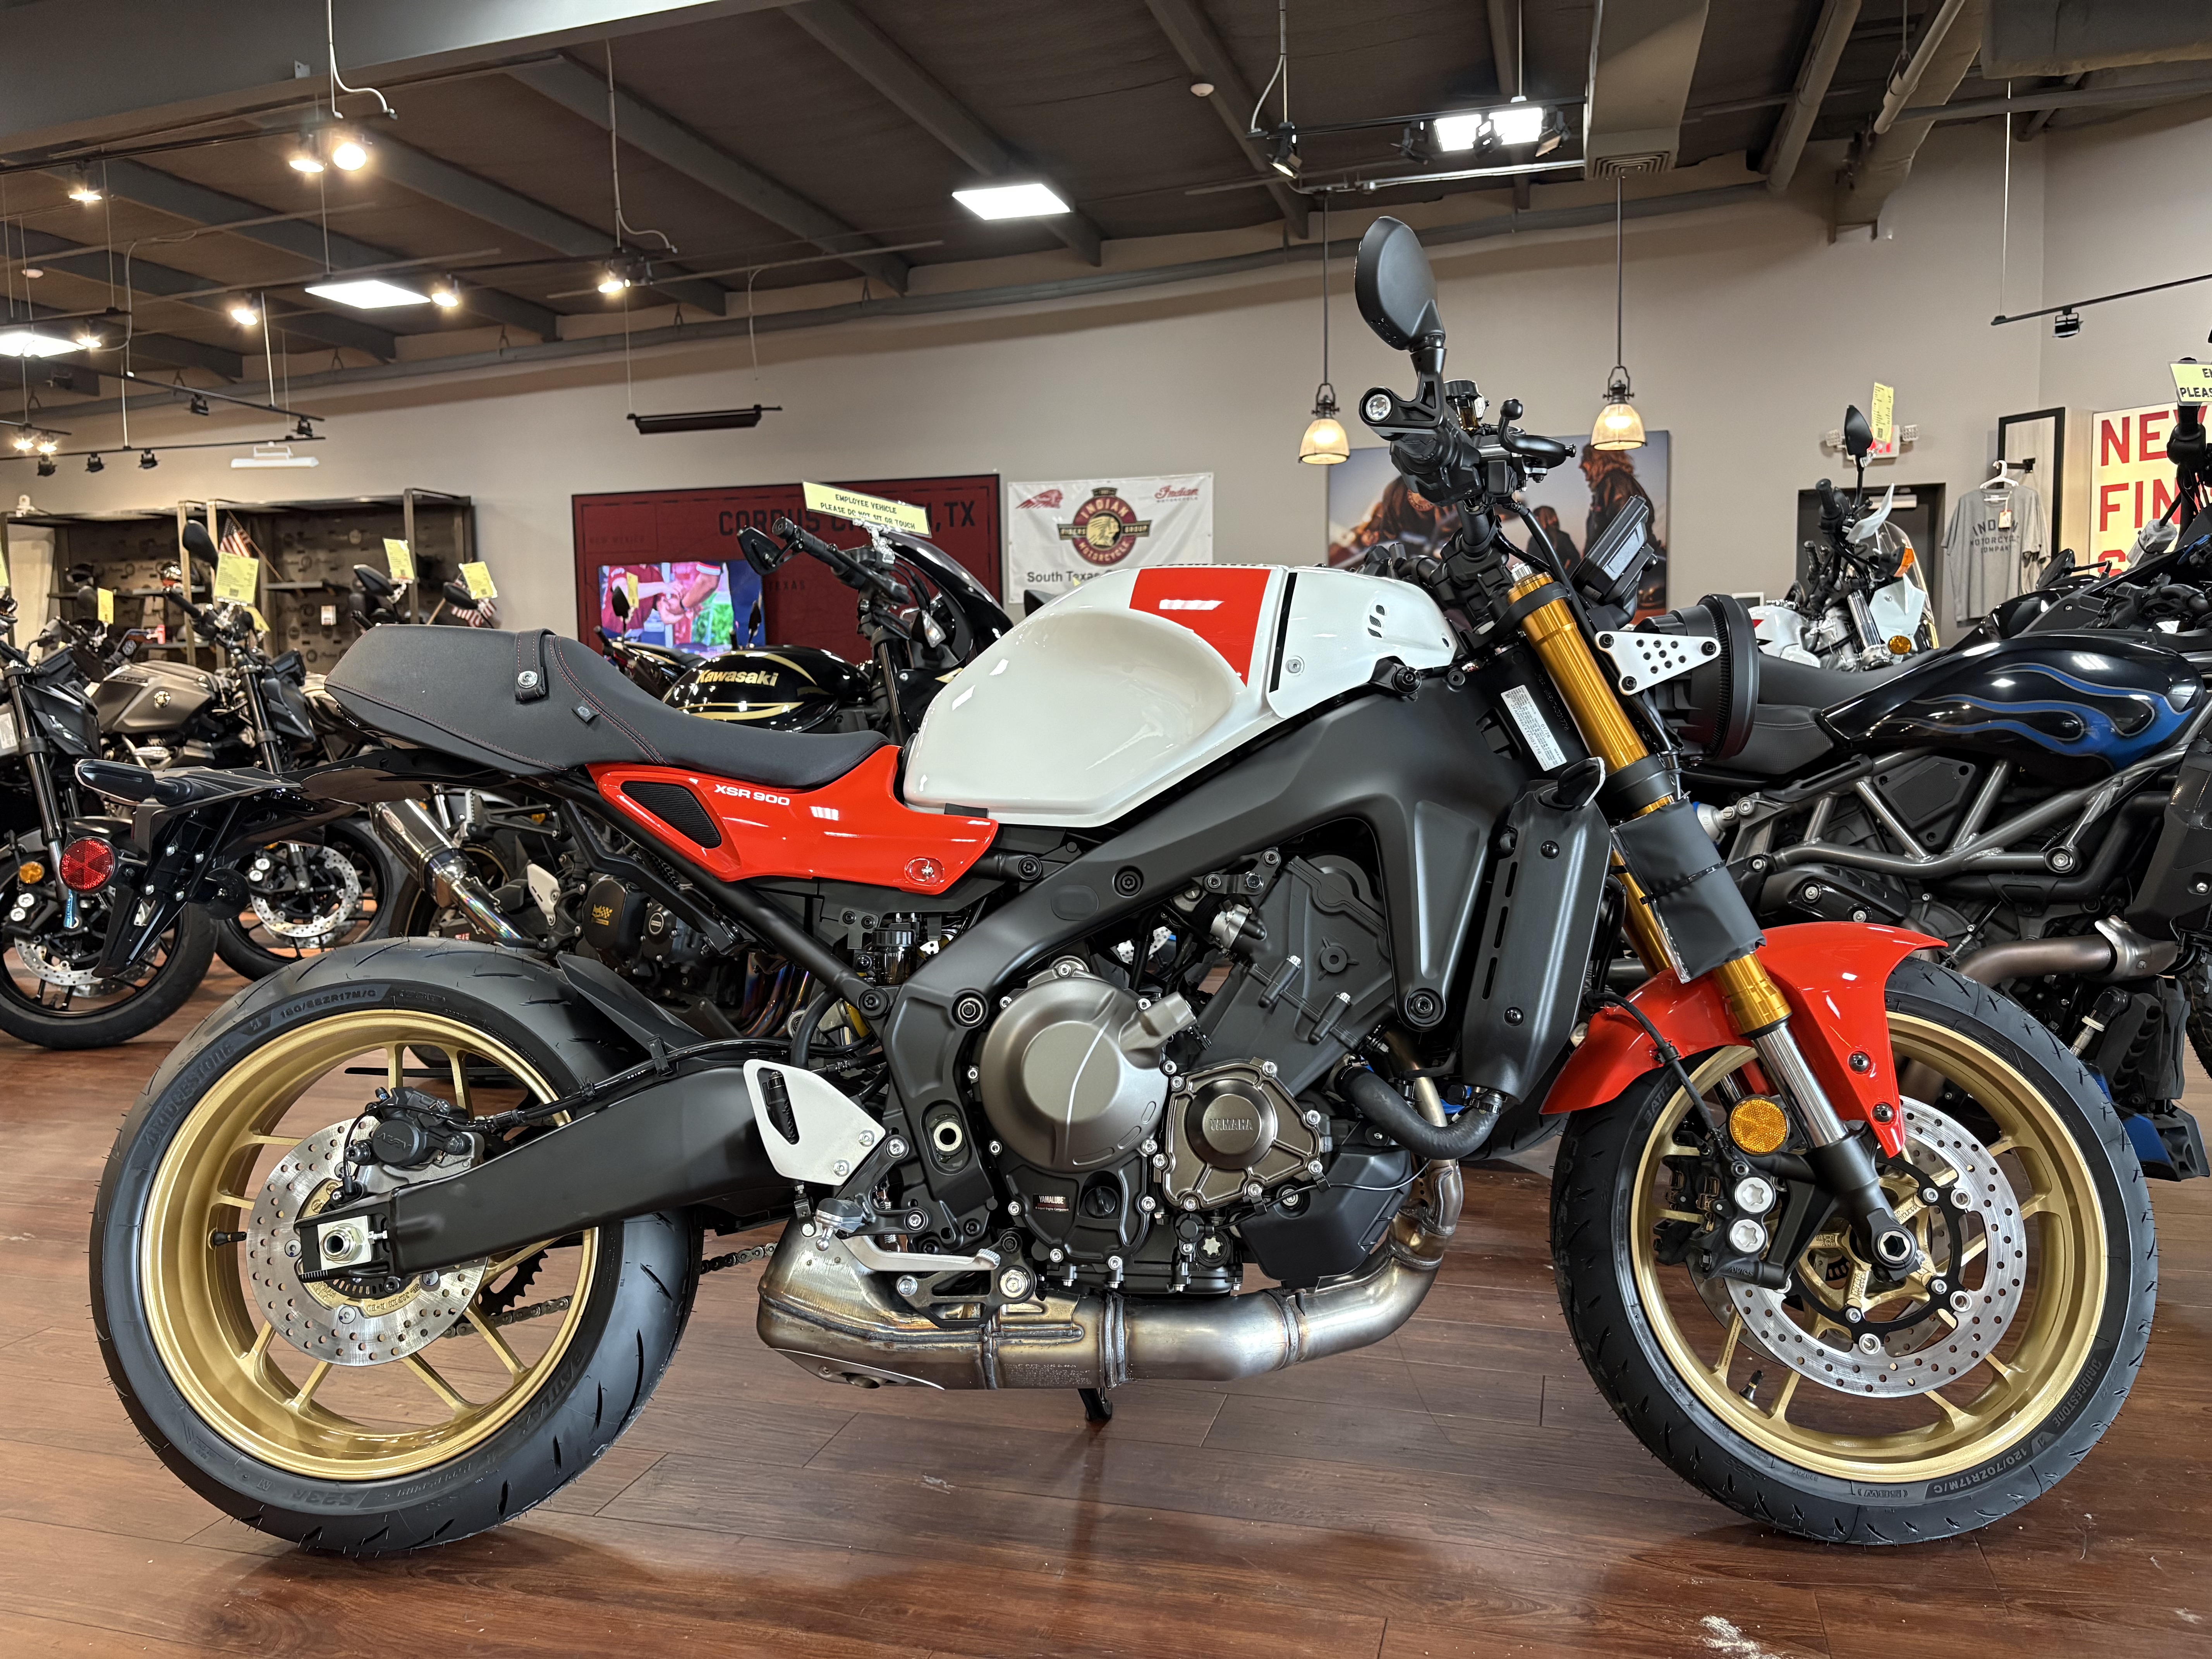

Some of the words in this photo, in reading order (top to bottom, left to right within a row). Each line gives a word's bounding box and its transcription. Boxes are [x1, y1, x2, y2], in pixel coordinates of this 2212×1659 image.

[2101, 405, 2208, 467] NE
[835, 494, 869, 507] EMPLOYEE
[871, 503, 897, 514] VEHICLE
[1080, 498, 1129, 519] INDIAN
[821, 502, 846, 514] PLEASE
[873, 514, 883, 522] SIT
[895, 519, 915, 530] TOUCH
[1972, 519, 2018, 536] INDN
[1078, 541, 1130, 562] MOTORCYCLE
[1027, 571, 1063, 582] South
[696, 669, 779, 687] Kawasaki
[714, 783, 752, 800] XSR
[754, 791, 790, 806] 900
[1210, 1118, 1253, 1130] YAMAHA
[2052, 1358, 2103, 1428] BRIDGESTONE
[1934, 1447, 2027, 1496] 120/70ZR17M/C
